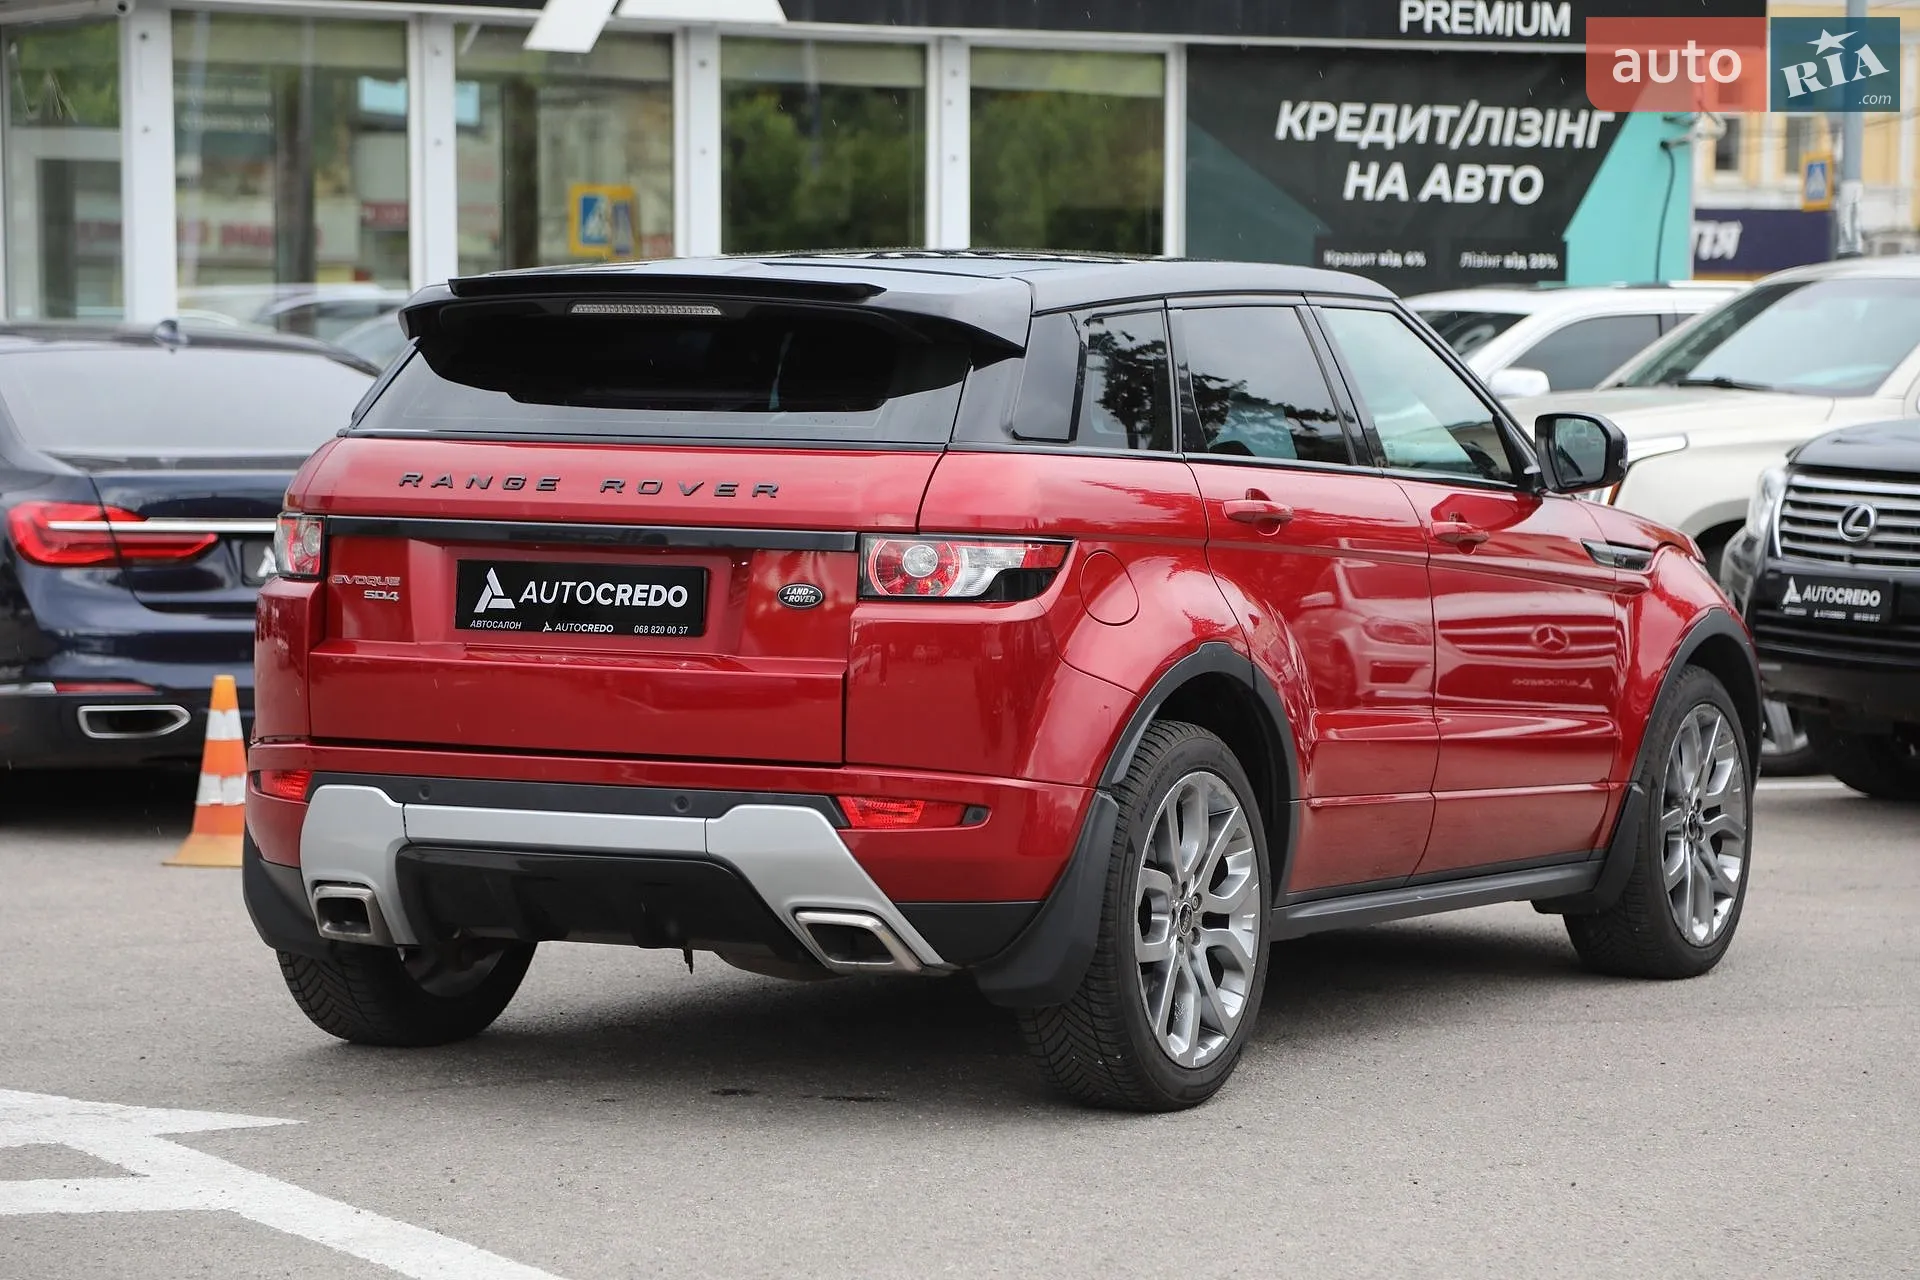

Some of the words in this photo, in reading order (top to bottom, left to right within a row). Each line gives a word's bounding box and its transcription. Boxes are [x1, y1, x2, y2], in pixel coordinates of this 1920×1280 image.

[1400, 0, 1572, 37] PREMIUM
[1275, 100, 1616, 150] КРЕДИТ/ЛІЗІНГ
[1342, 161, 1409, 202] НА
[1418, 163, 1545, 206] АВТО
[1323, 249, 1377, 268] Кредит
[399, 472, 560, 492] RANGE
[600, 478, 780, 498] ROVER
[331, 574, 401, 587] EVOQUE
[363, 589, 400, 602] SD4
[518, 580, 689, 608] AUTOCREDO
[786, 587, 810, 596] LAND
[788, 595, 816, 603] ROVER
[1802, 584, 1881, 607] AUTOCREDO
[469, 619, 522, 631] АВТОСАЛОН
[554, 622, 614, 634] AUTOCREDO
[633, 624, 650, 635] 068
[650, 624, 665, 635] 820
[666, 625, 677, 635] 00
[678, 625, 689, 636] 37
